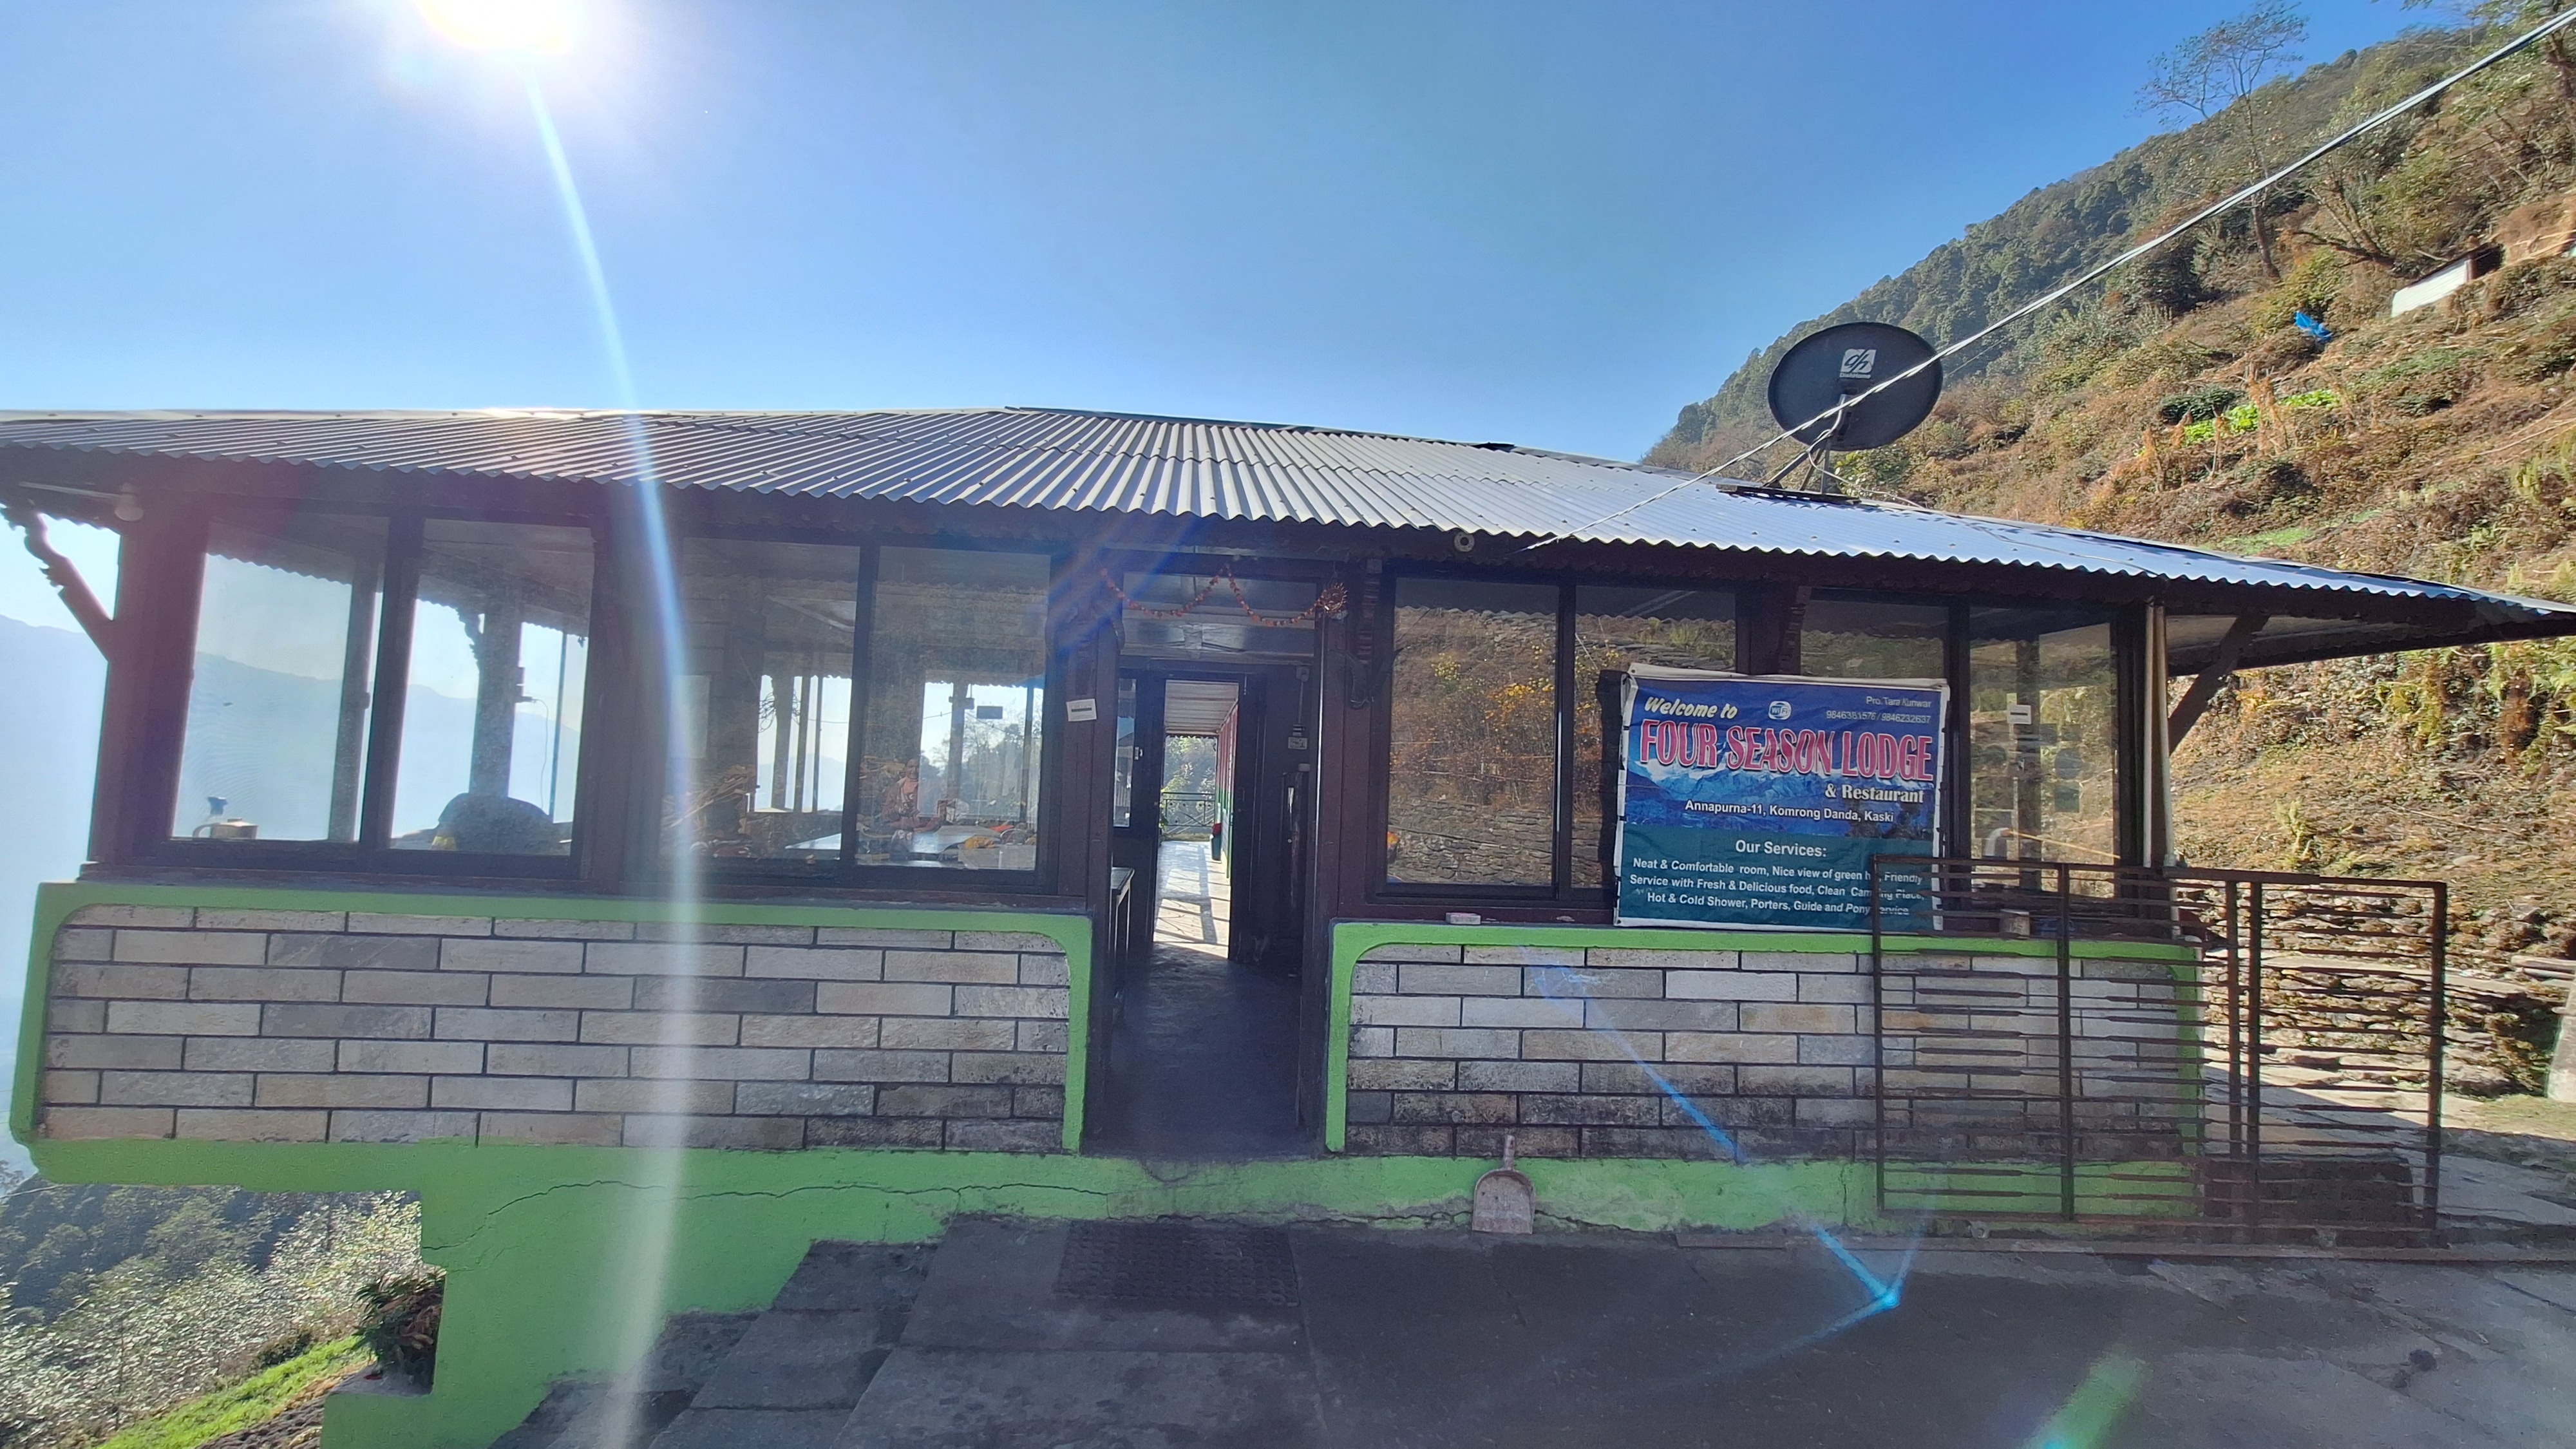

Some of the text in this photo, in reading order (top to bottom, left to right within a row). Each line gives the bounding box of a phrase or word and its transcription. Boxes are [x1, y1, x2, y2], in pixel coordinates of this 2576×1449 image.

[1645, 696, 1738, 719] Welcome to
[1866, 696, 1932, 708] Pro. Tara Kunwar
[1640, 719, 1933, 781] FOUR SEASON LODGE
[1824, 783, 1924, 803] & Restaurant
[1685, 799, 1894, 822] Annapurna-11, Komrong Danda, Kaski
[1736, 840, 1827, 857] Our Services:
[1633, 858, 1658, 869] Neat
[1660, 860, 1668, 869] &
[1671, 860, 1734, 873] Comfortable
[1740, 866, 1769, 877] room,
[1772, 866, 1795, 876] Nice
[1797, 867, 1821, 878] view
[1823, 869, 1833, 878] of
[1835, 871, 1862, 882] green
[1884, 872, 1922, 885] Friendly
[1630, 875, 1668, 886] Service
[1671, 876, 1694, 887] with
[1697, 879, 1725, 890] Fresh
[1728, 881, 1736, 891] &
[1739, 881, 1786, 893] Delicious
[1789, 882, 1815, 895] food,
[1817, 886, 1845, 896] Clean
[1647, 893, 1666, 902] Hot
[1668, 893, 1676, 903] &
[1680, 895, 1704, 905] Cold
[1707, 896, 1748, 909] Shower,
[1751, 898, 1791, 911] Porters,
[1794, 901, 1823, 912] Guide
[1824, 902, 1844, 912] and
[1846, 904, 1871, 915] Pony
